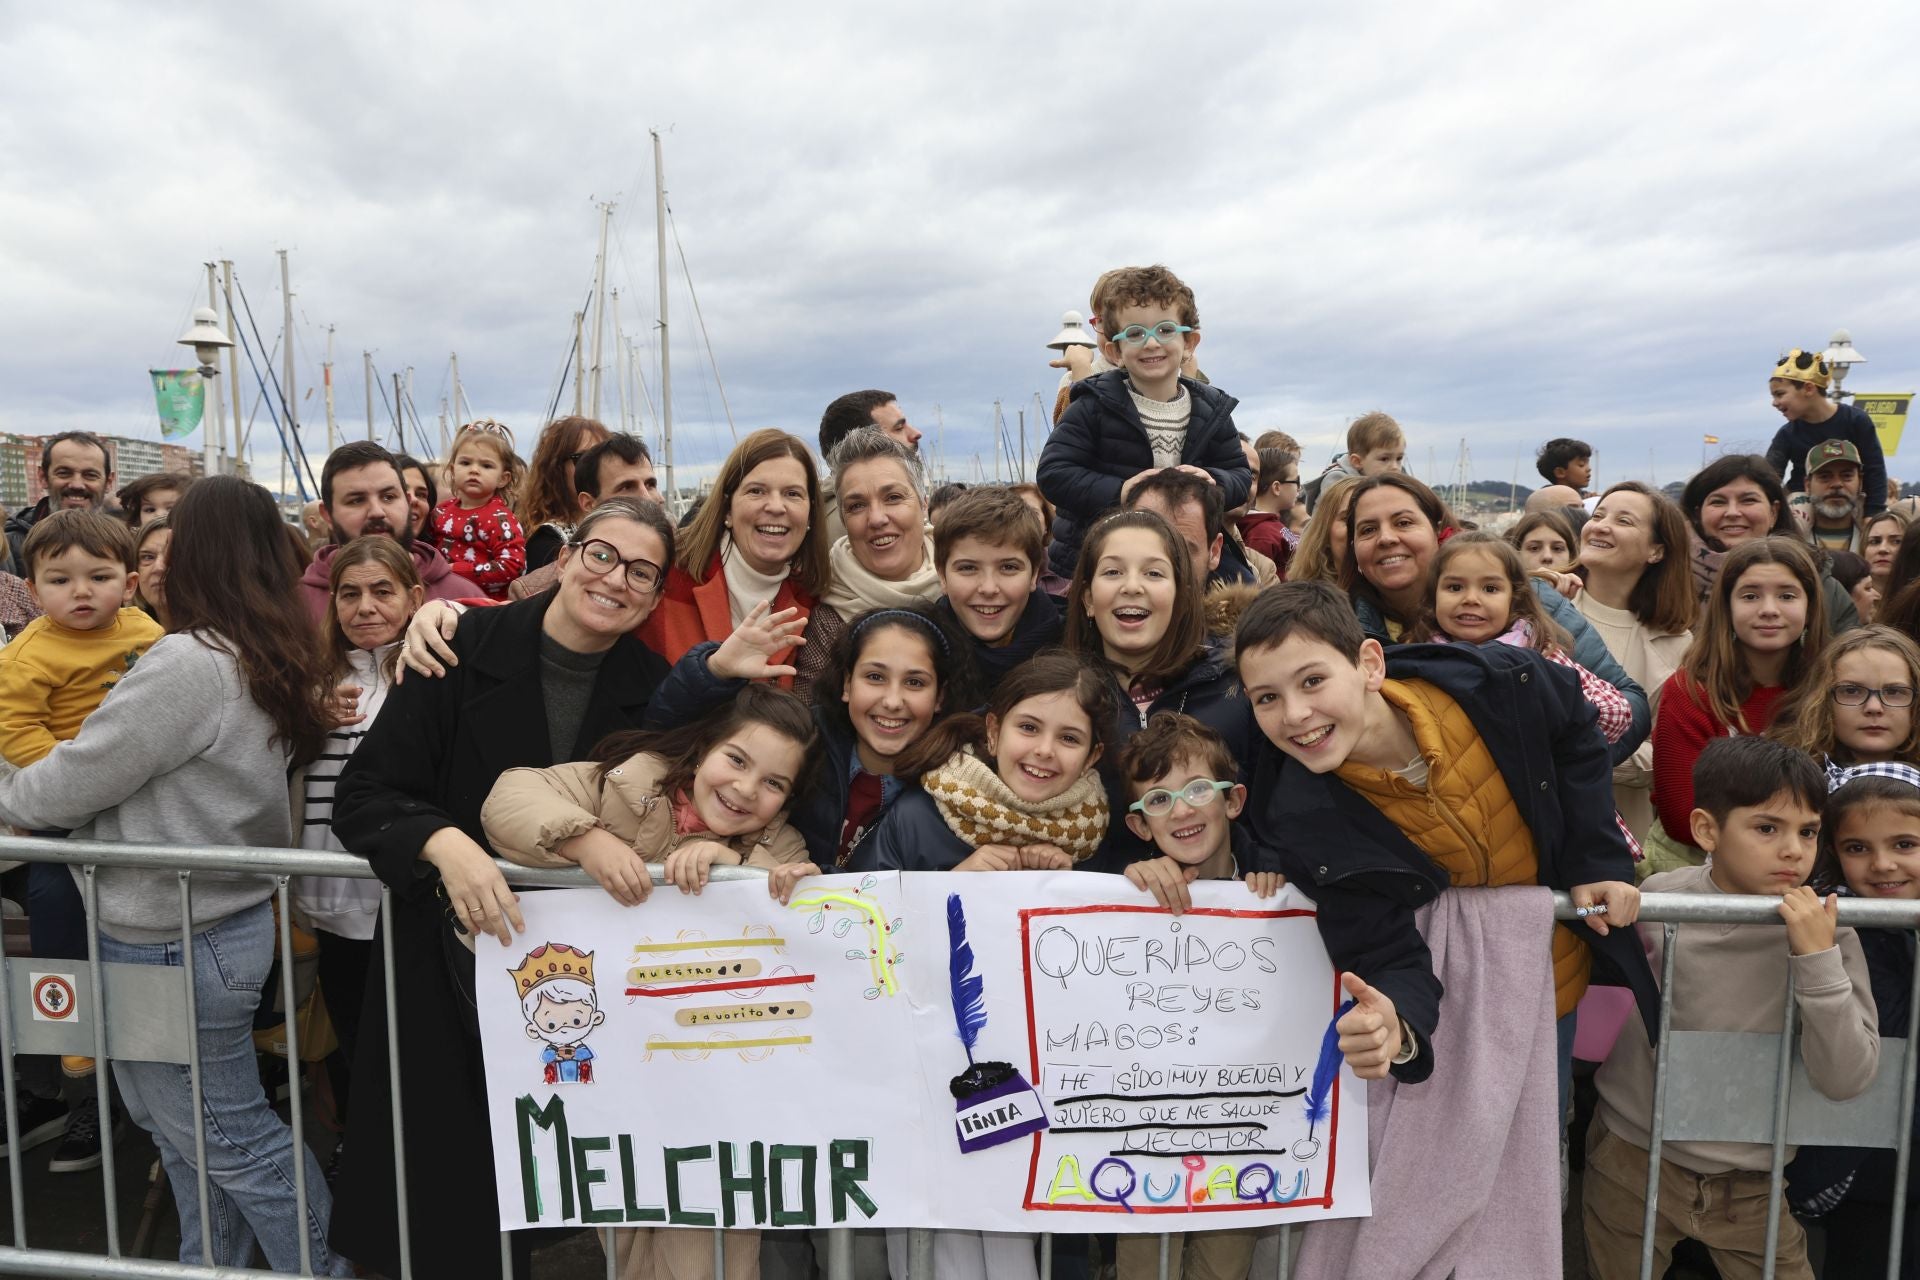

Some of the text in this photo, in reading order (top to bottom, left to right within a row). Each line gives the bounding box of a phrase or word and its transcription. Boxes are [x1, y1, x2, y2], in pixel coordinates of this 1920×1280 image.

[1125, 981, 1261, 1014] REYES
[1060, 1073, 1095, 1091] HE
[1172, 1069, 1208, 1087] MUY
[1217, 1066, 1282, 1086] BUENA
[1295, 1066, 1306, 1082] Y
[1139, 1106, 1179, 1122] QUE
[1187, 1104, 1213, 1120] ME
[1220, 1101, 1281, 1118] SALUDE
[1122, 1128, 1265, 1152] MELCHOR
[515, 1093, 879, 1227] MELCHOR
